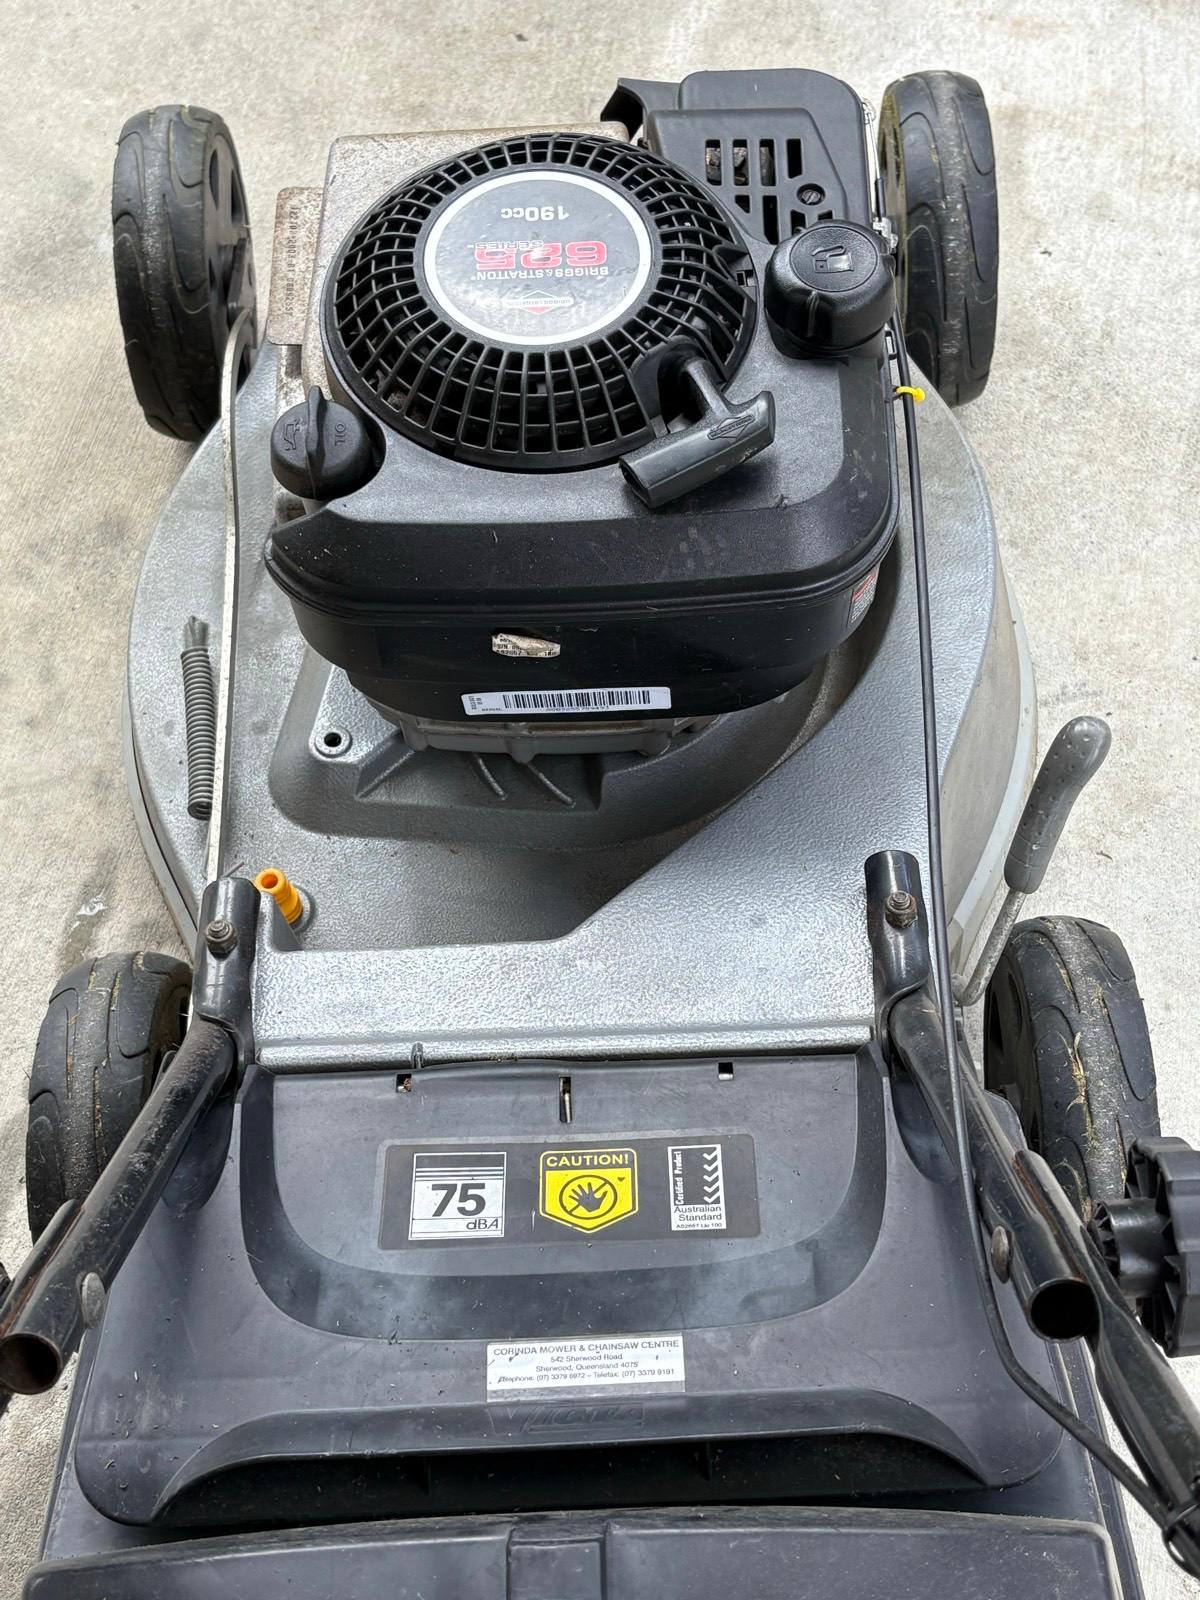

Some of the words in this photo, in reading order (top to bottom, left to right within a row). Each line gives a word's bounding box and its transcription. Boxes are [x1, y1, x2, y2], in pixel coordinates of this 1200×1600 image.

[500, 205, 570, 221] 190cc
[474, 239, 544, 252] SERIES
[474, 240, 608, 270] 625
[334, 423, 347, 447] OIL
[546, 1153, 629, 1167] CAUTION!
[673, 1150, 682, 1174] Product
[674, 1176, 684, 1205] Certified
[431, 1183, 486, 1217] 75
[674, 1205, 722, 1214] Australian
[466, 1218, 499, 1230] dBA
[678, 1213, 722, 1222] Standard
[493, 1346, 538, 1356] CORINDA
[540, 1344, 576, 1354] MOWER
[579, 1344, 586, 1352] &
[588, 1342, 639, 1352] CHAINSAW
[641, 1340, 679, 1349] CENTRE
[566, 1353, 602, 1362] Sherwood
[603, 1353, 623, 1361] Road
[535, 1364, 574, 1373] Sherwood,
[575, 1362, 619, 1371] Queensland
[536, 1374, 550, 1382] (07)
[621, 1370, 636, 1378] (07)
